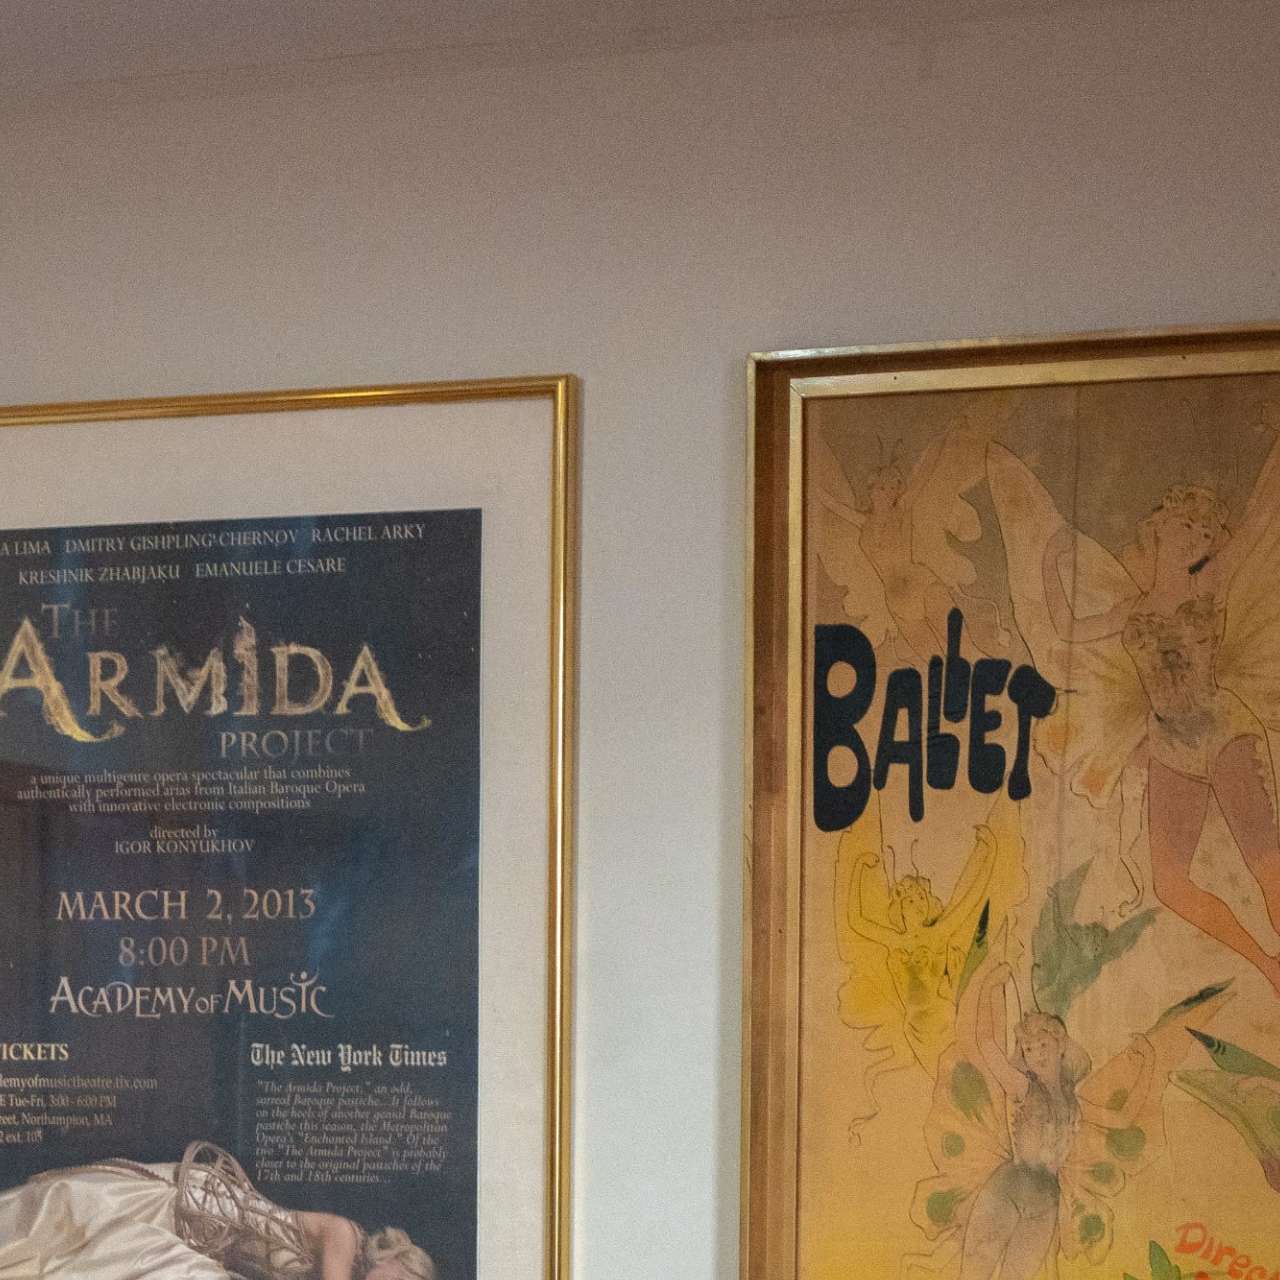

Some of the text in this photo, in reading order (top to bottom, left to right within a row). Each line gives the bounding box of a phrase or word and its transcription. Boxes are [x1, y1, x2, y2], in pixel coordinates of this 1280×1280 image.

[14, 539, 51, 556] LIMA
[64, 535, 125, 553] DMITRY
[310, 525, 378, 543] RACHEL
[381, 523, 426, 540] ARKY
[18, 566, 96, 586] KRESHNIK
[195, 559, 282, 579] EMANUELE
[286, 556, 347, 576] CESARE
[40, 602, 120, 641] THE
[812, 606, 1056, 832] BALLET
[218, 726, 375, 762] PROJECT
[16, 779, 366, 803] authentically performed arias from Italian Baroque Opera
[40, 774, 81, 789] unique
[153, 771, 188, 787] opera
[191, 766, 259, 786] spectacular
[263, 765, 288, 780] that
[290, 764, 352, 780] combines
[69, 796, 312, 815] with innovative electronic compositions
[114, 838, 257, 855] IGOR KONYUKHOV
[149, 823, 219, 840] directed by
[55, 887, 317, 925] MARCH 2, 2013
[119, 936, 252, 967] 8:00 PM
[250, 1042, 448, 1073] The New York Times
